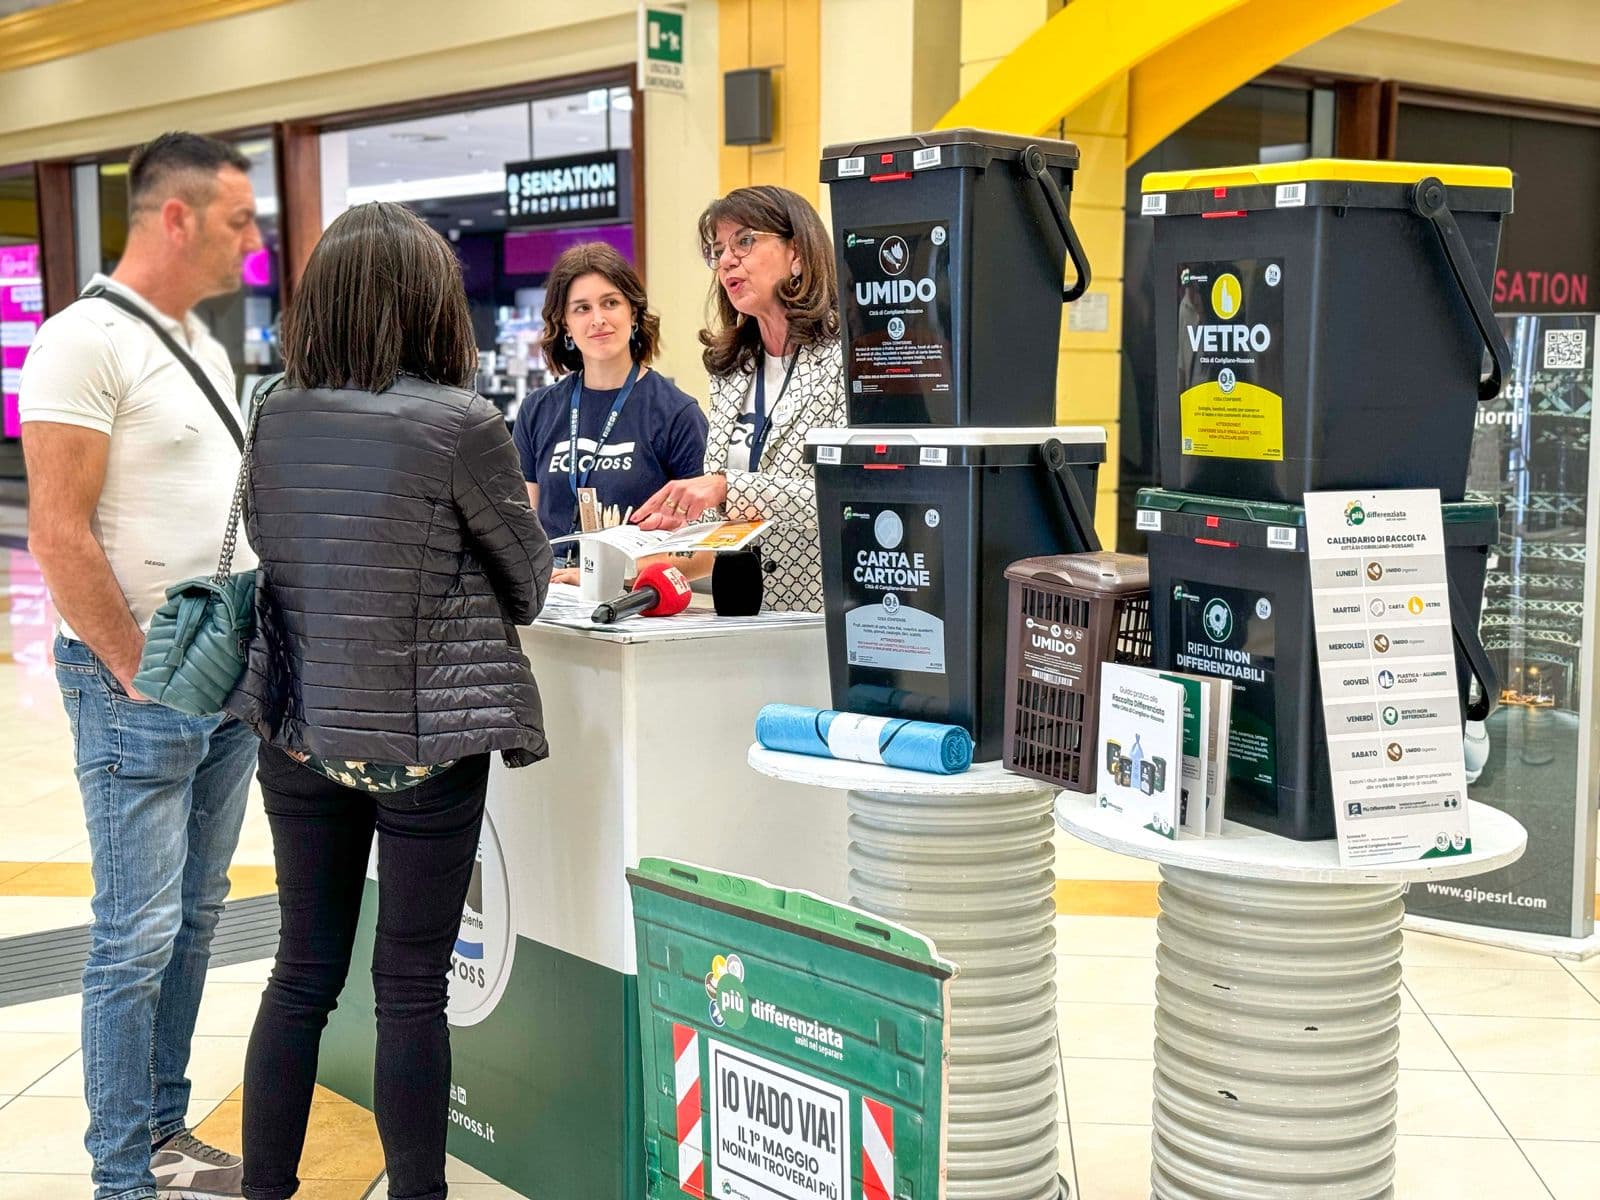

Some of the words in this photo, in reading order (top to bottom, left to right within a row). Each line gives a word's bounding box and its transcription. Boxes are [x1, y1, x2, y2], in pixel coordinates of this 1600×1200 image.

[521, 163, 615, 197] SENSATION
[856, 278, 937, 306] UMIDO
[1187, 323, 1271, 352] VETRO
[1366, 510, 1406, 518] differenziata
[1327, 536, 1375, 545] CALENDARIO
[1376, 535, 1385, 543] DI
[1386, 534, 1426, 542] RACCOLTA
[857, 550, 910, 569] CARTA
[913, 552, 925, 569] E
[853, 566, 930, 587] CARTONE
[1336, 568, 1358, 577] LUNEDÌ
[1333, 605, 1360, 614] MARTEDÌ
[1032, 634, 1076, 655] UMIDO
[1187, 641, 1222, 660] RIFIUTI
[1225, 648, 1251, 665] NON
[1329, 642, 1364, 650] MERCOLEDÌ
[1176, 653, 1265, 682] DIFFERENZIABILI
[1343, 677, 1369, 686] GIOVEDÌ
[1347, 713, 1373, 722] VENERDÌ
[1426, 883, 1547, 909] www.gipesrl.com
[721, 989, 744, 1013] più
[751, 999, 844, 1049] differenziata
[795, 1036, 808, 1049] uniti
[808, 1039, 818, 1051] nel
[818, 1044, 844, 1061] separare
[722, 1067, 740, 1113] IO
[744, 1076, 793, 1135] VADO
[798, 1097, 836, 1155] VIA!
[738, 1125, 748, 1145] IL
[762, 1135, 819, 1175] MAGGIO
[722, 1137, 746, 1161] NON
[748, 1149, 760, 1167] MI
[762, 1156, 817, 1194] TROVERAI
[819, 1181, 838, 1200] PIÙ
